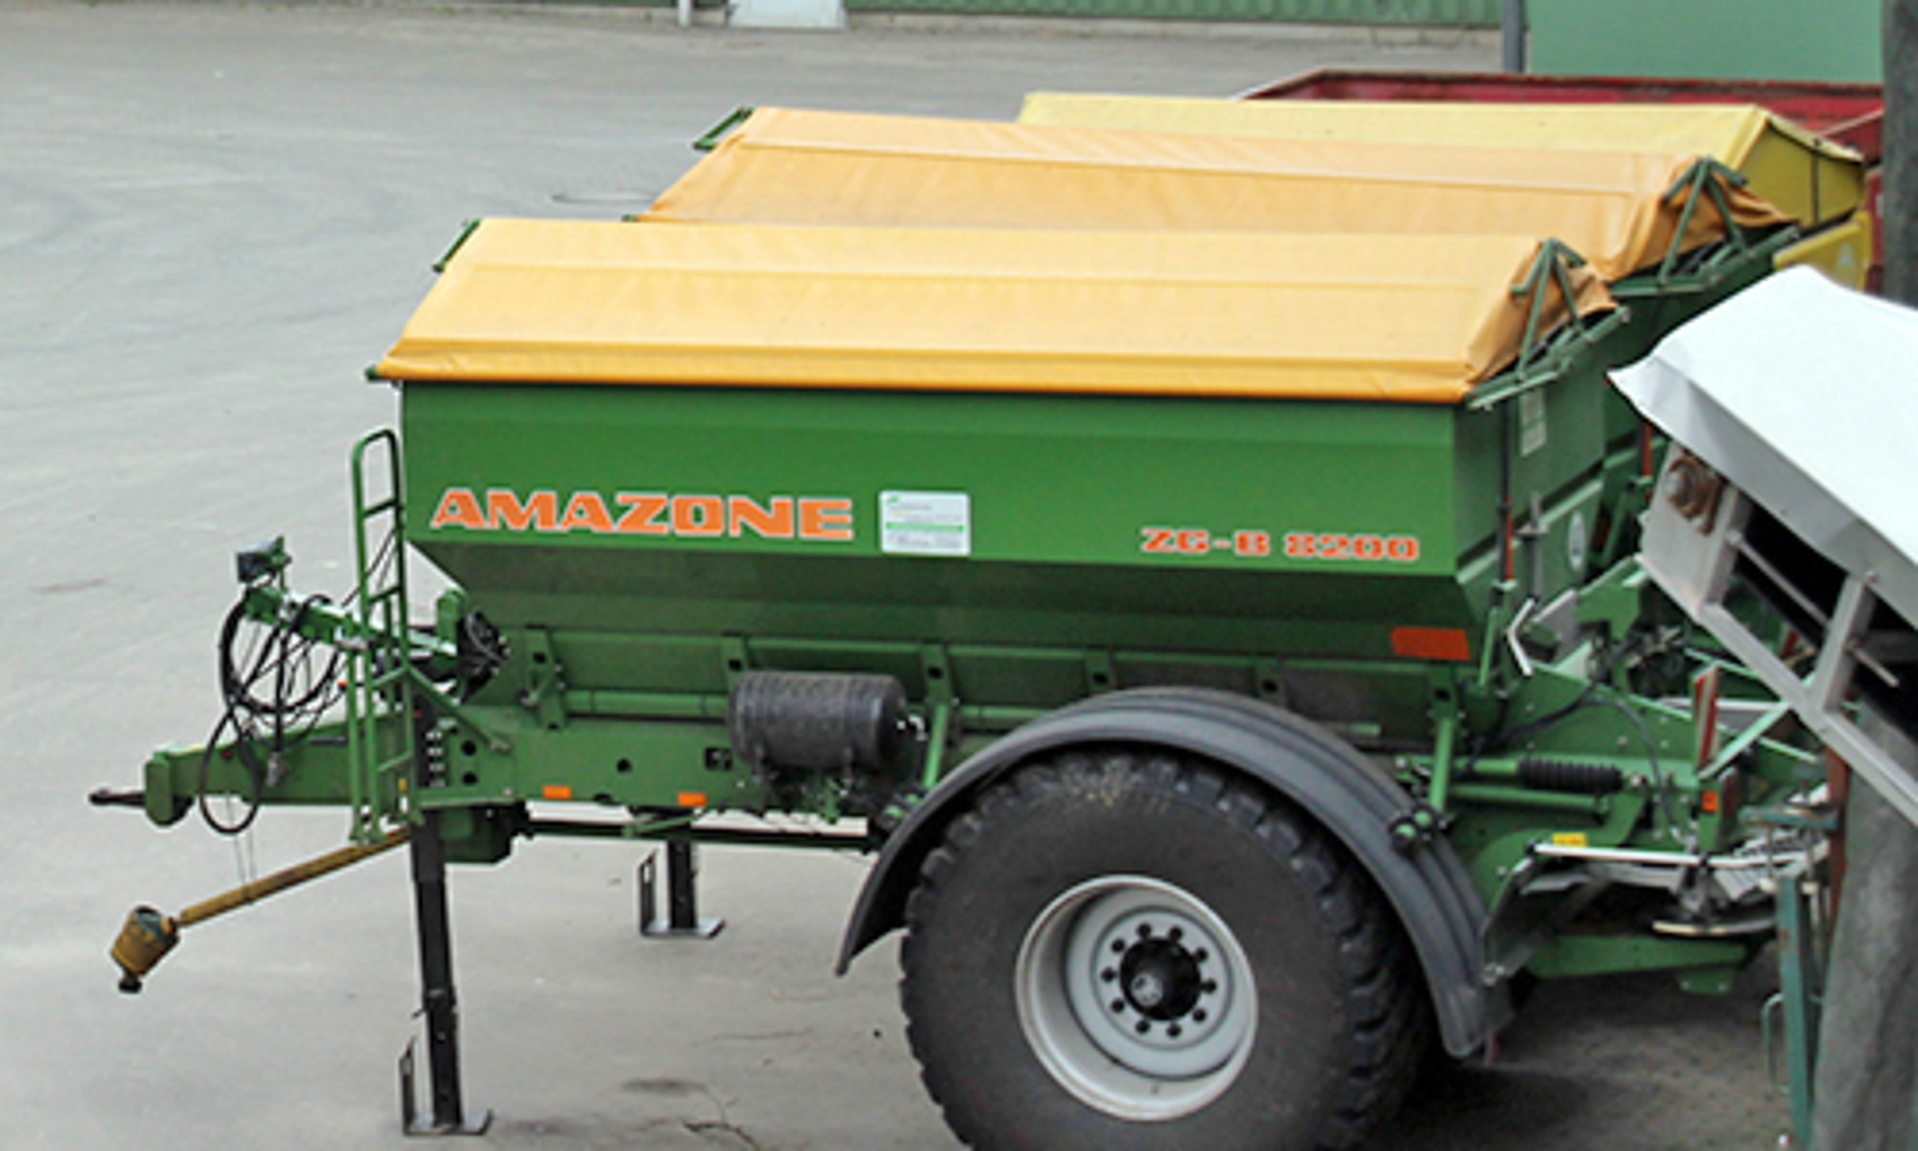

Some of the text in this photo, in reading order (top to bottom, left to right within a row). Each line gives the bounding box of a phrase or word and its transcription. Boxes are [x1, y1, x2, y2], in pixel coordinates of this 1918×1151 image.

[430, 487, 854, 540] AMAZONE
[1141, 527, 1419, 560] ZG-B 8200
